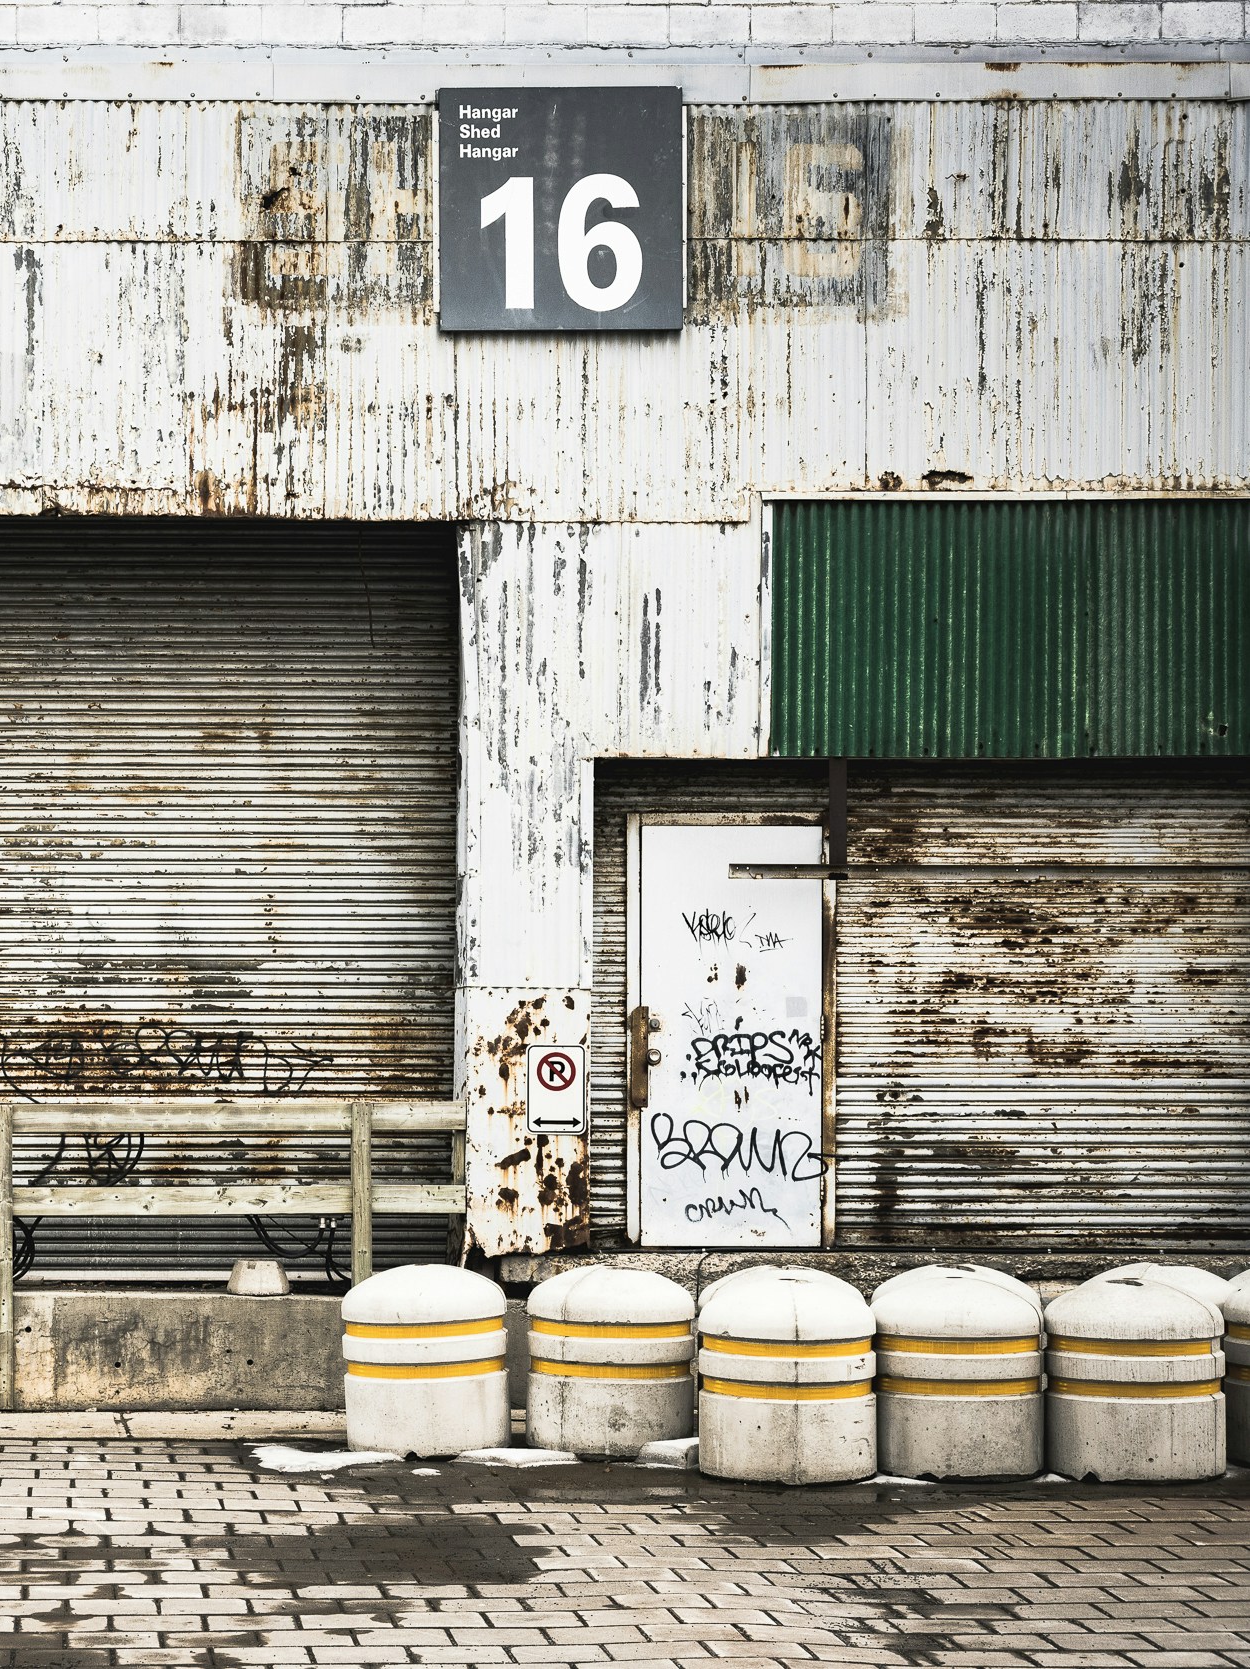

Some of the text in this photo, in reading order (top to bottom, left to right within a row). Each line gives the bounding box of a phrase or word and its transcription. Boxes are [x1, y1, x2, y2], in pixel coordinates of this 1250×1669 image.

[459, 105, 518, 122] Hangar
[459, 124, 501, 138] Shed
[459, 144, 518, 161] Hangar
[480, 173, 643, 312] 16
